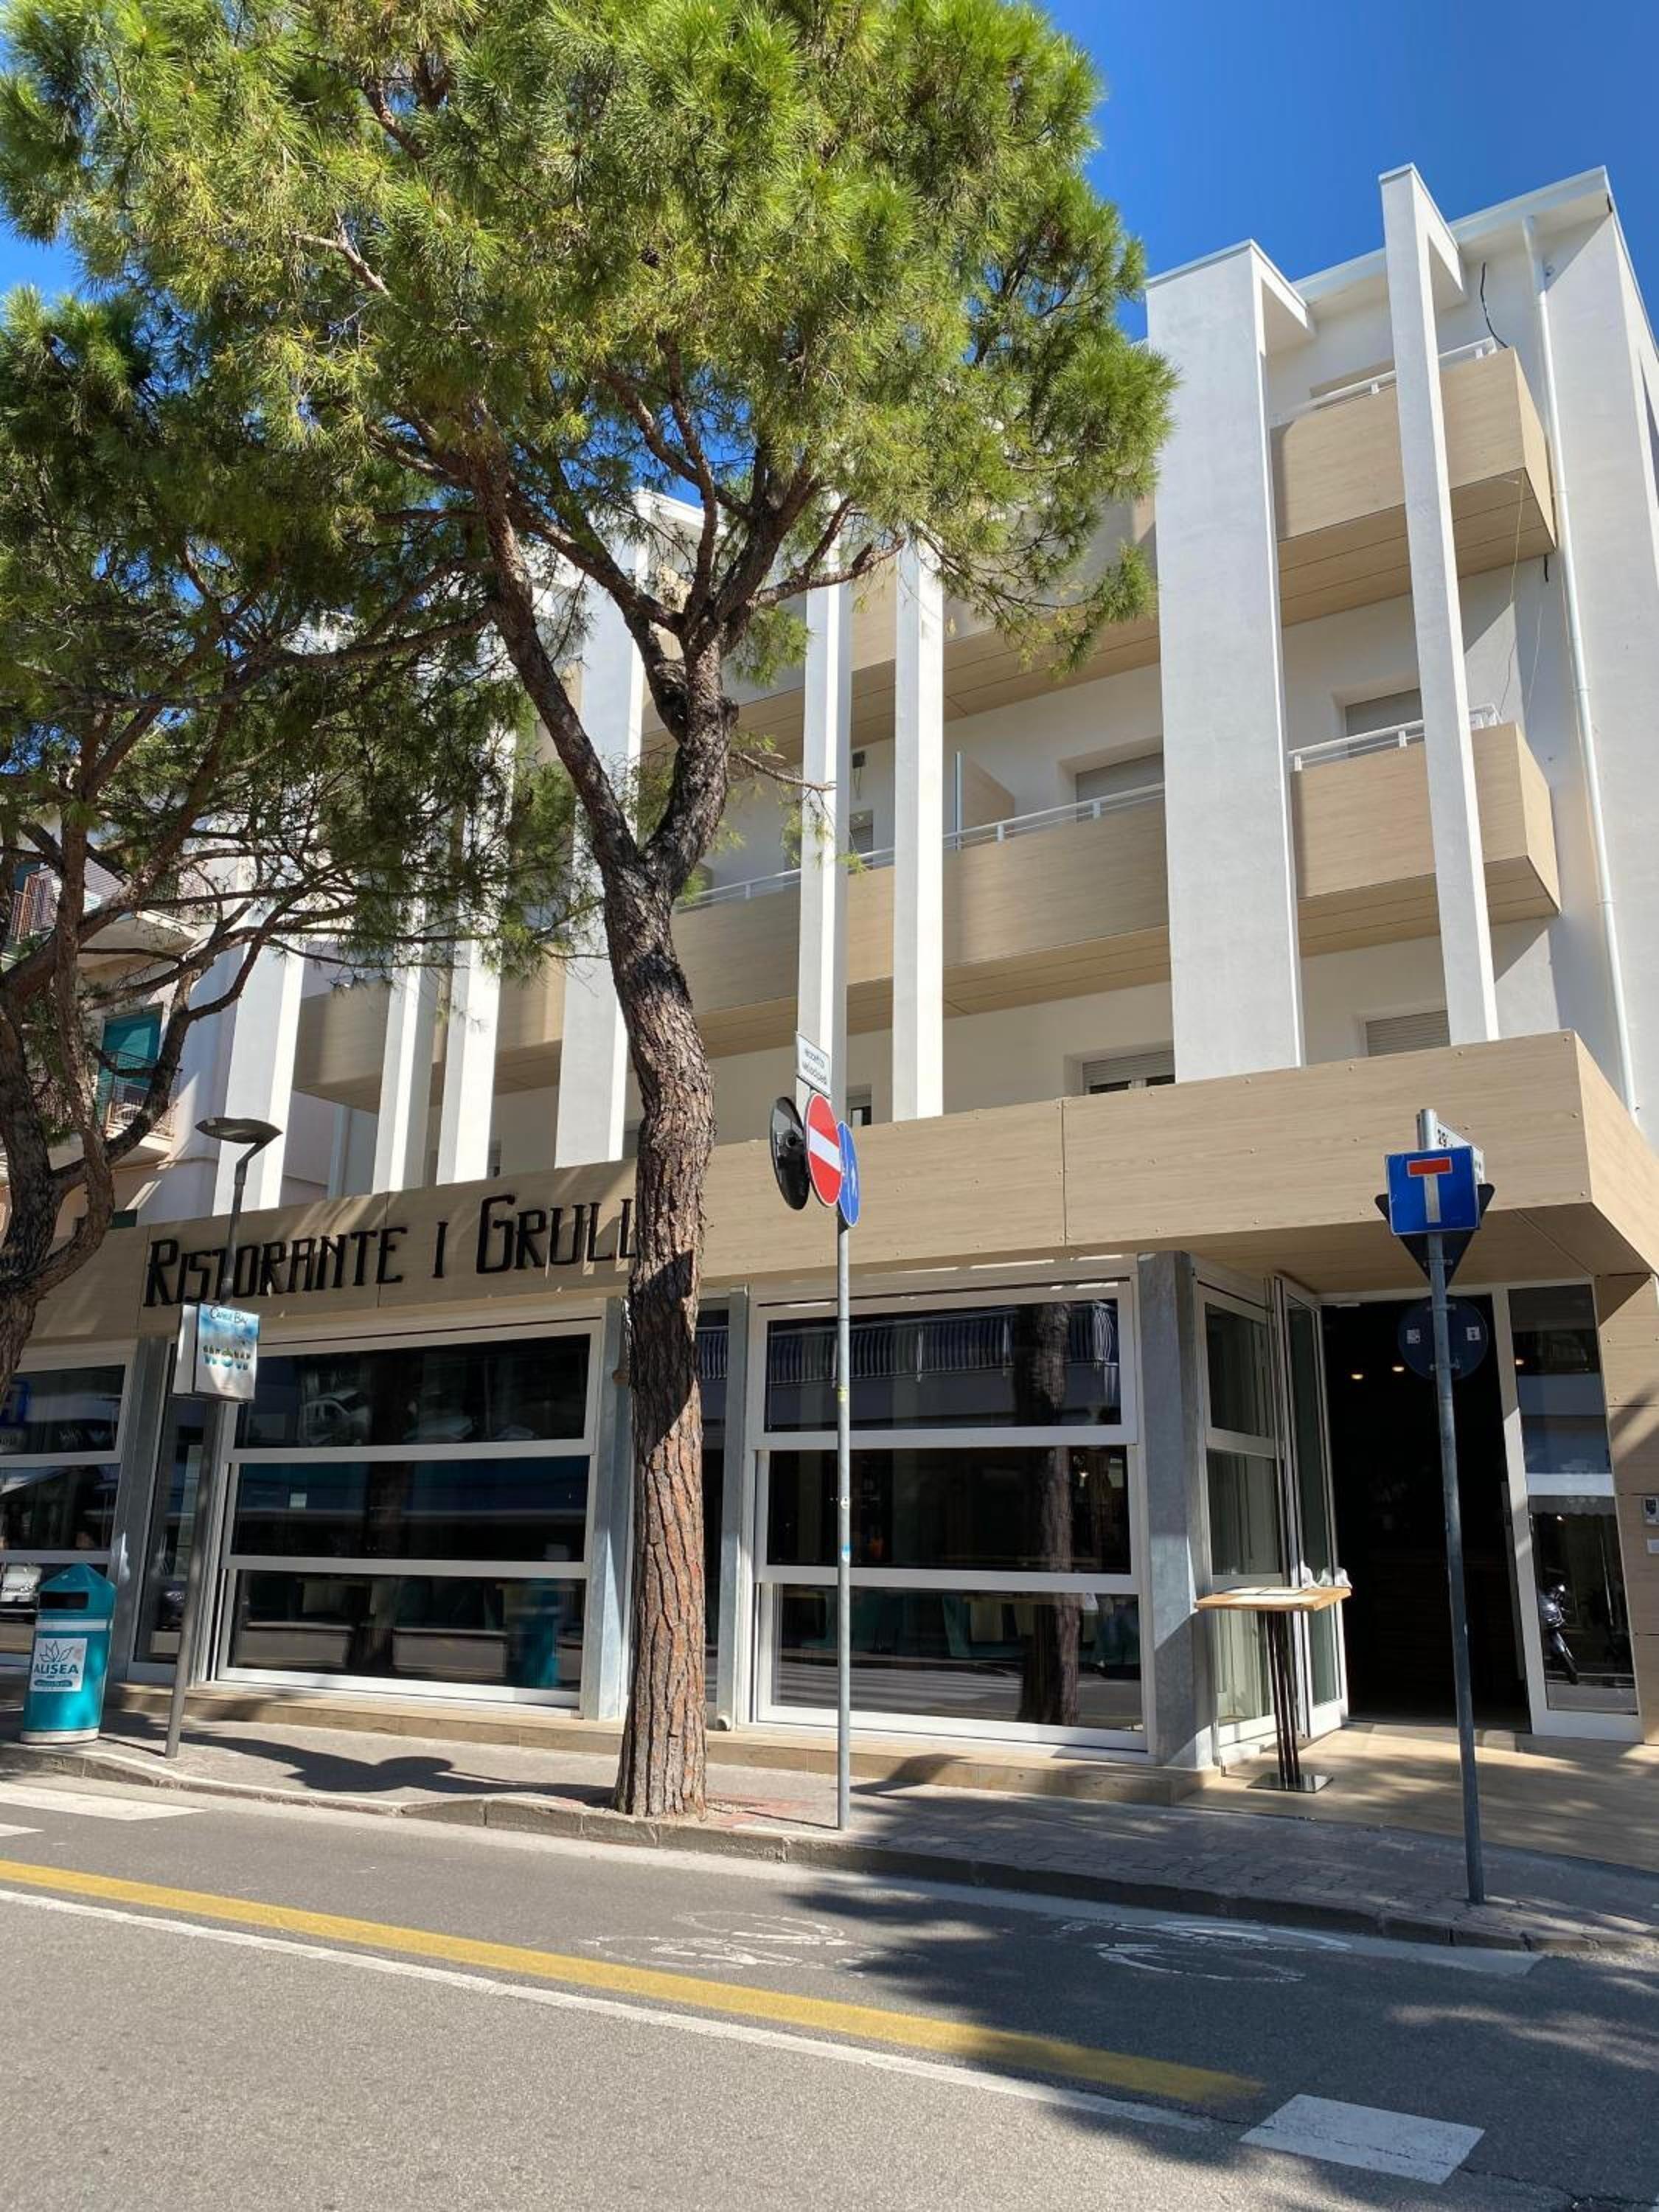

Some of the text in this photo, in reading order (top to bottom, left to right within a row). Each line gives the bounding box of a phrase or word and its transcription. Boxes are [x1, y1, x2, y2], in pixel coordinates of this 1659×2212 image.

[143, 1194, 636, 1307] RISTORANTE I GRULL
[33, 1663, 79, 1674] ALISEA
